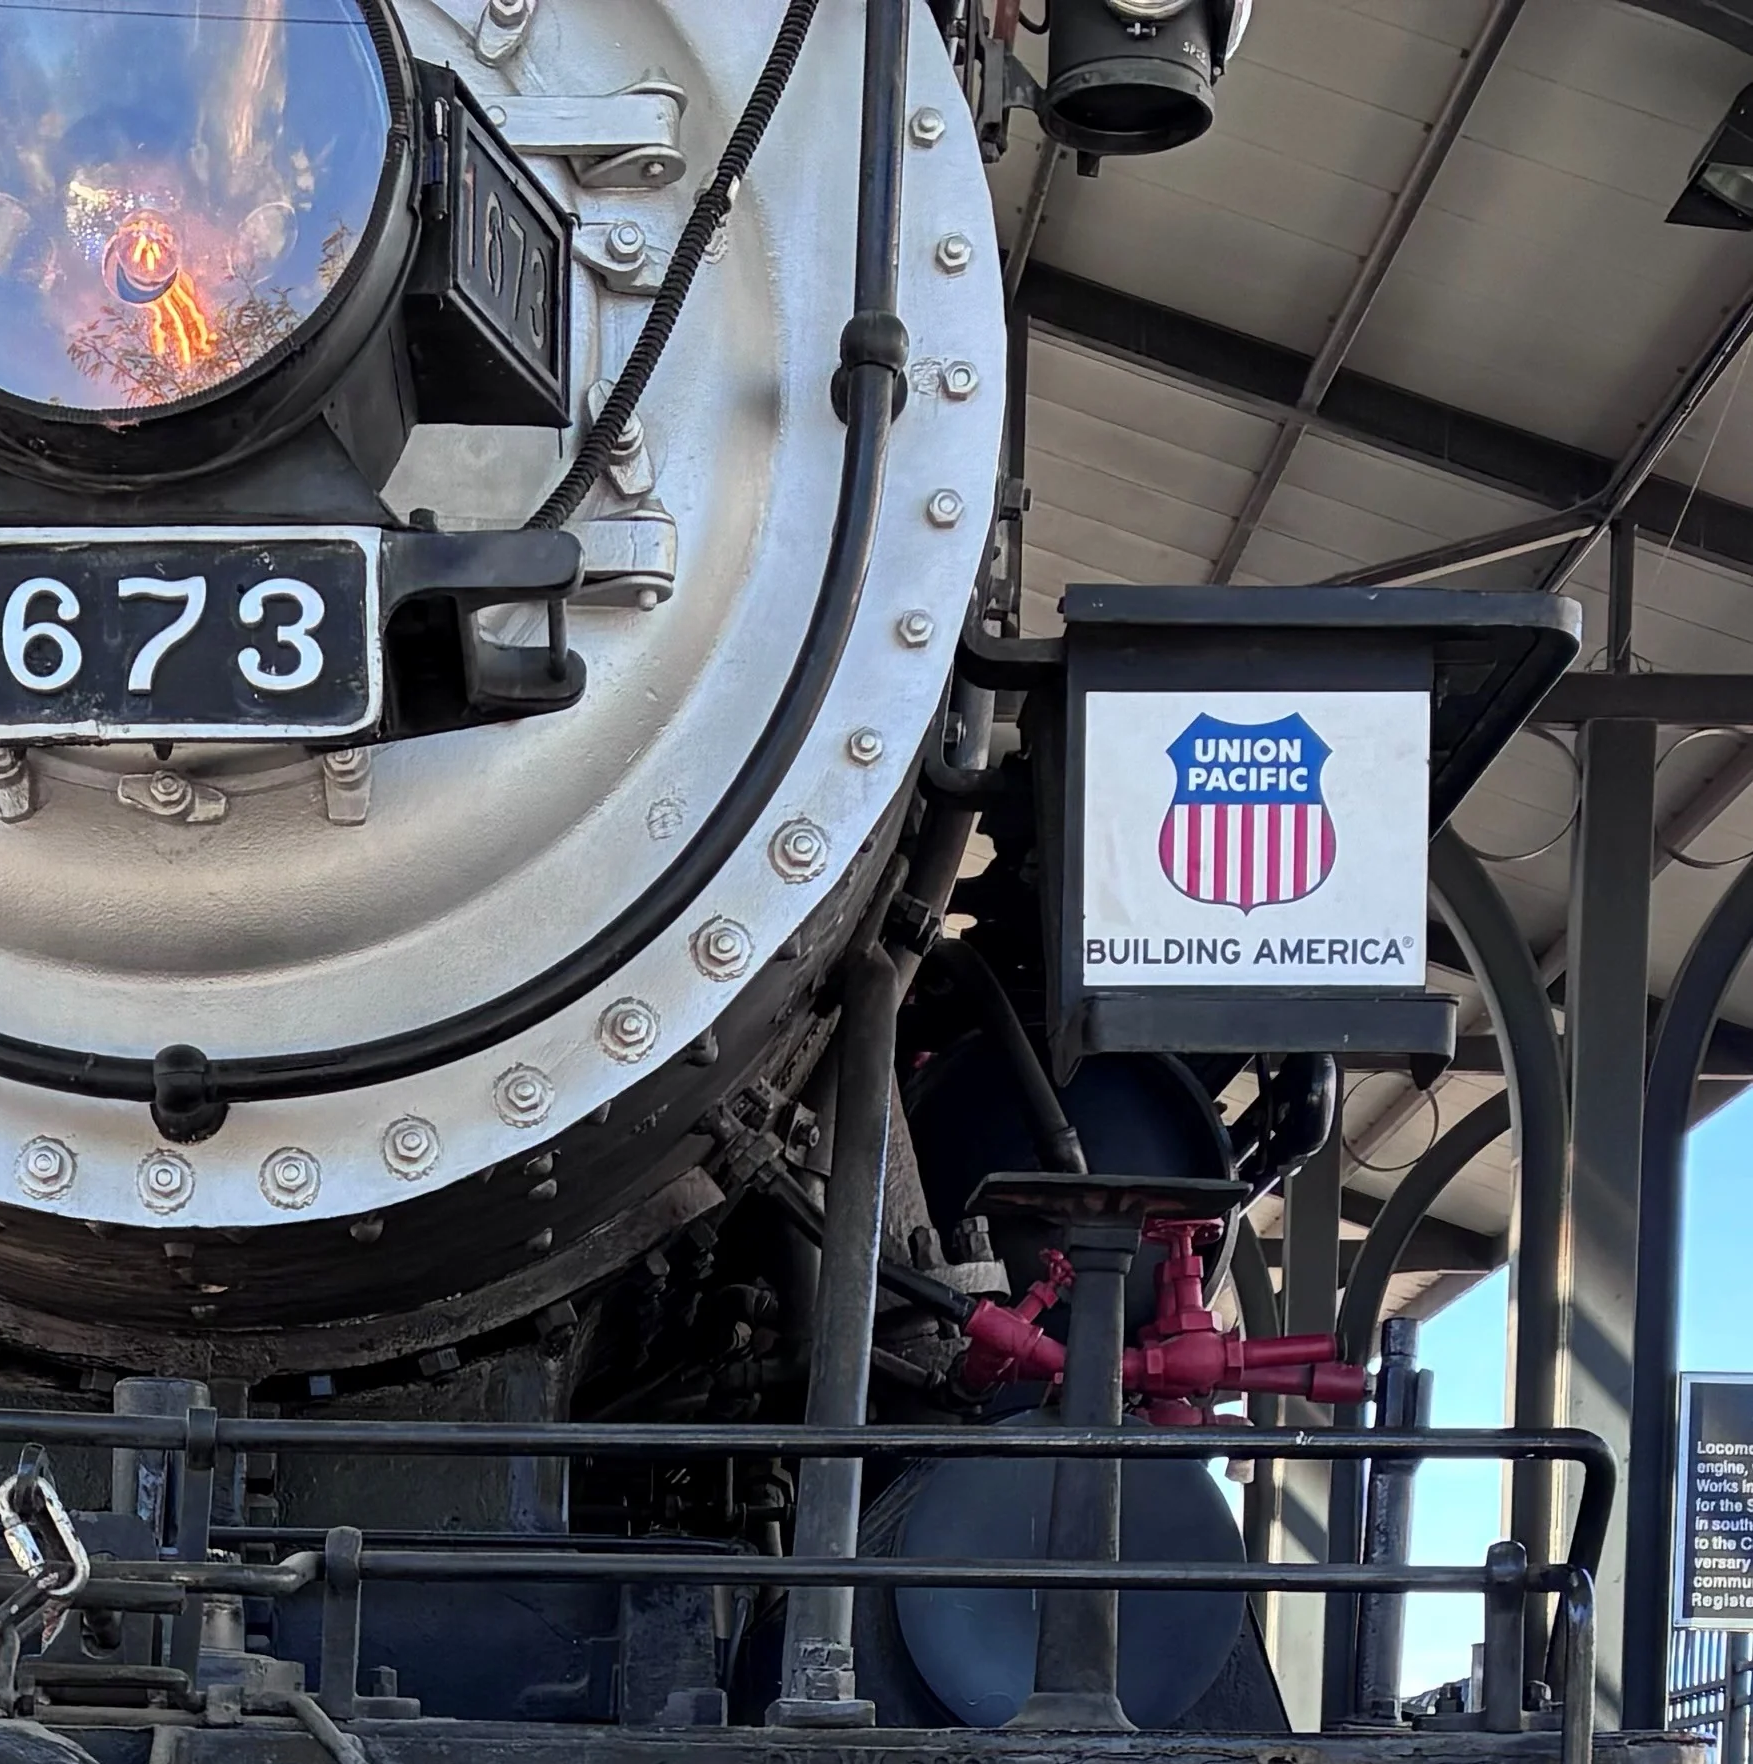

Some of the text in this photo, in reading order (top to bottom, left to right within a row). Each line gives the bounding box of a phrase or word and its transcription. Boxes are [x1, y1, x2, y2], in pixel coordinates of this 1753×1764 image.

[464, 162, 546, 349] 1673
[1195, 738, 1301, 763] UNION
[1188, 767, 1308, 792] PACIFIC
[1086, 938, 1241, 965] BUILDING
[1697, 1460, 1748, 1477] engine,
[1696, 1479, 1739, 1493] Works
[1695, 1497, 1715, 1512] for
[1719, 1498, 1743, 1512] the
[1695, 1516, 1708, 1531] in
[1694, 1536, 1709, 1550] to
[1711, 1536, 1737, 1550] the
[1694, 1557, 1751, 1573] versary
